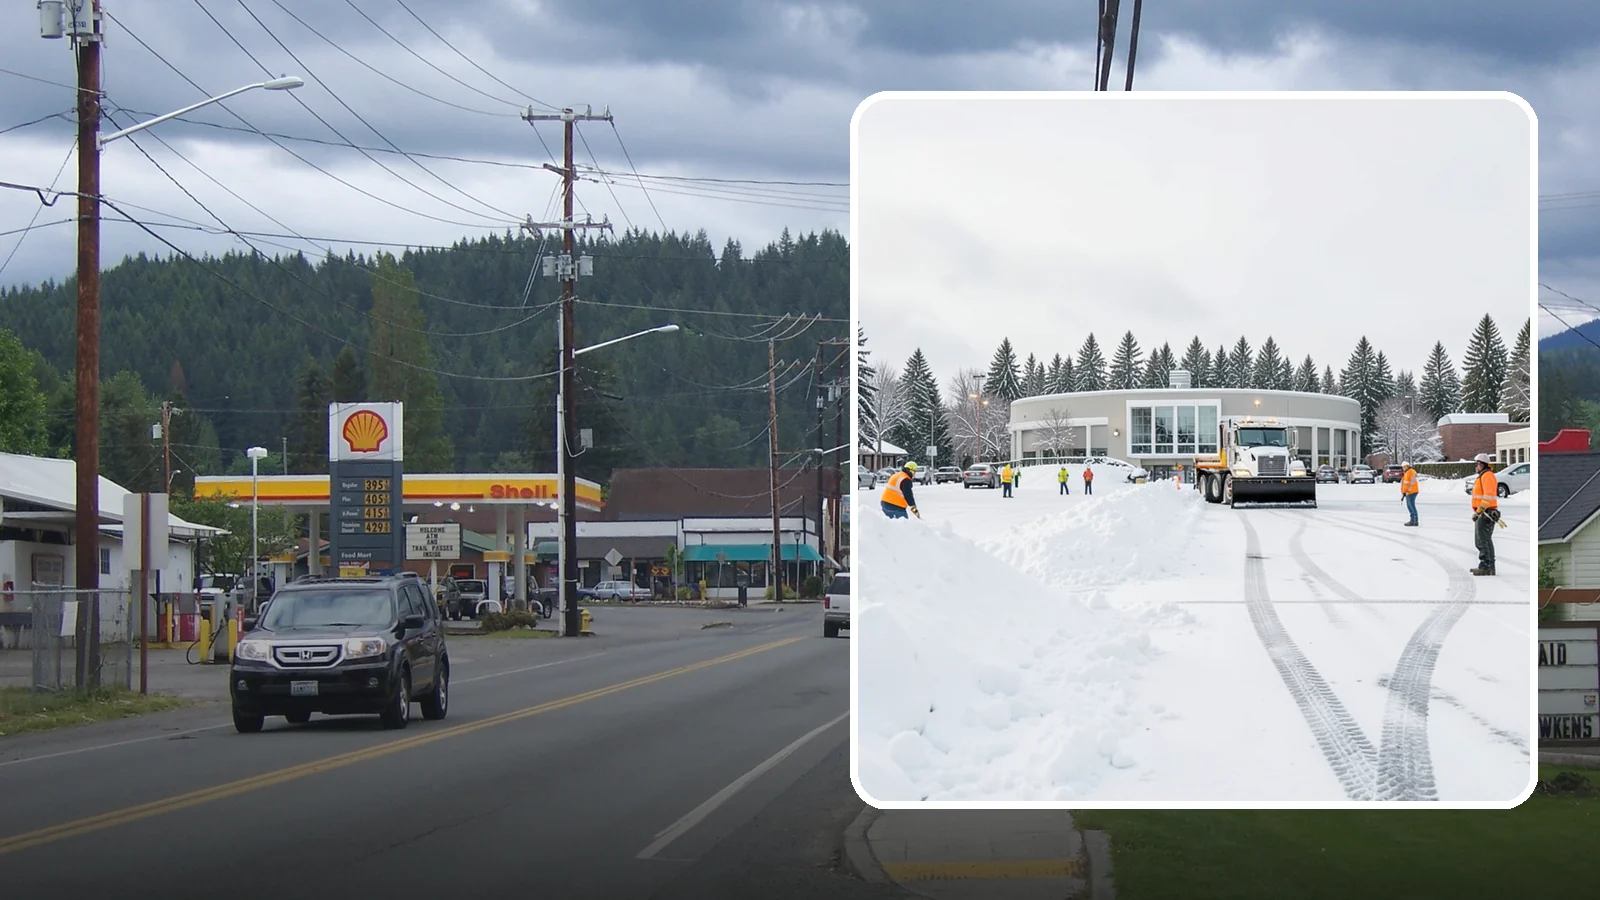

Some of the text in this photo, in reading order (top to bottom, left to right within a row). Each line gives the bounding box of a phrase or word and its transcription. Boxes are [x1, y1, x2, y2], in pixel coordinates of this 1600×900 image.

[366, 480, 384, 490] 395
[490, 484, 547, 498] Shell
[366, 494, 384, 504] 405
[366, 508, 383, 518] 415
[366, 522, 383, 532] 429
[1539, 643, 1566, 666] AID
